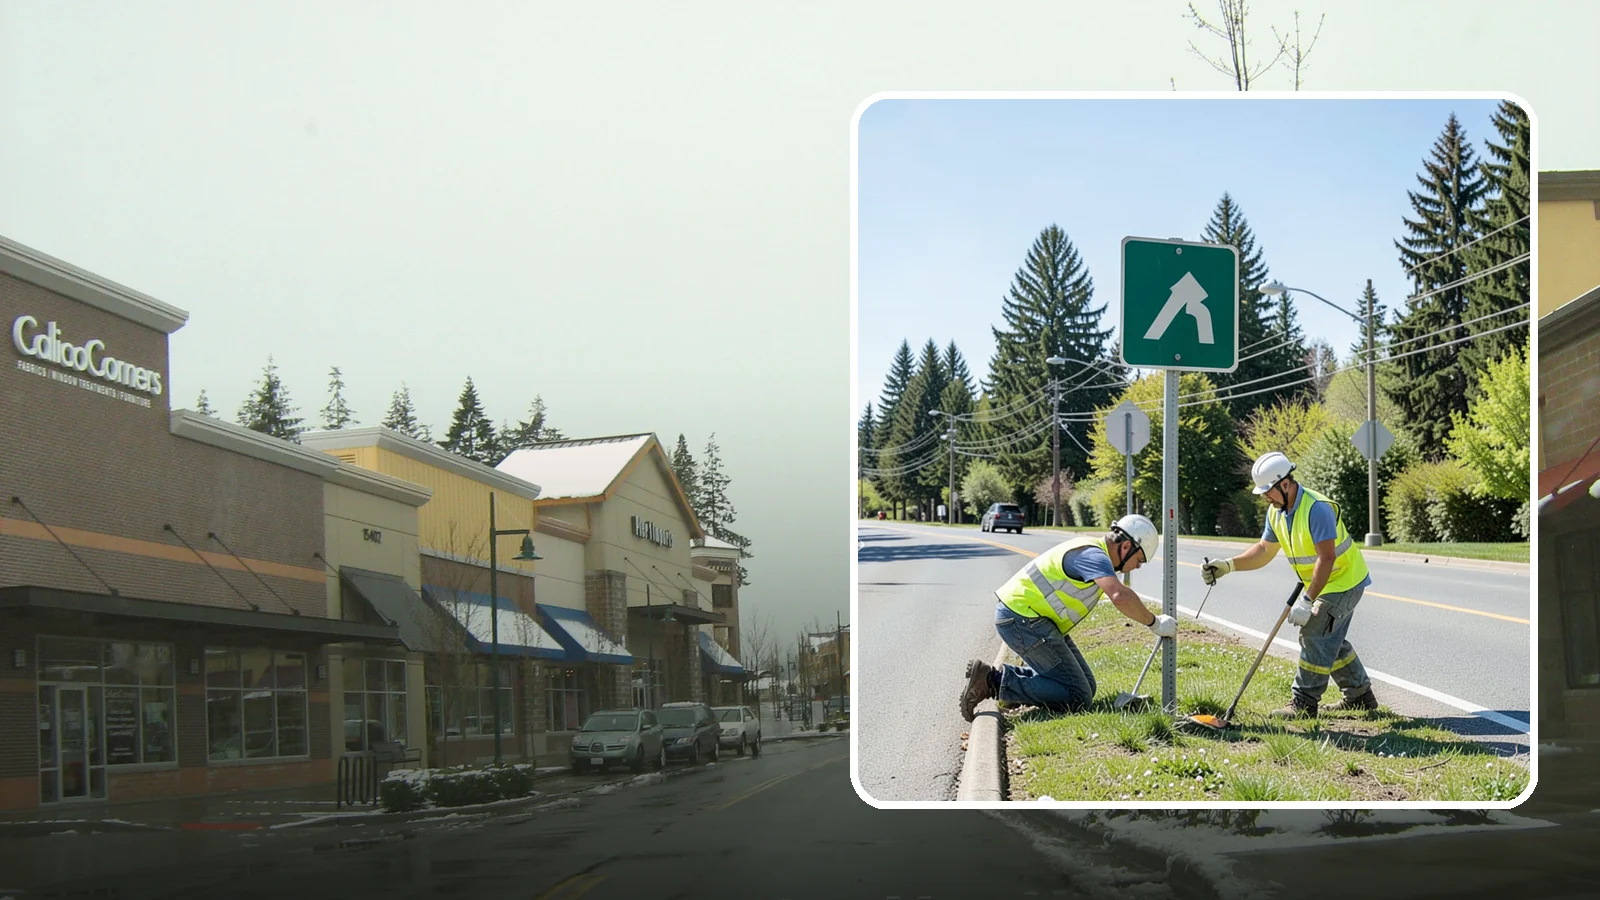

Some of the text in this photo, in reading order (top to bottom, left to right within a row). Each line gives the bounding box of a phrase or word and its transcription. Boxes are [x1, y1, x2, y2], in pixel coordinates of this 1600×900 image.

[16, 360, 151, 409] FABRICS WINDOW TREATMENTS FURNITURE
